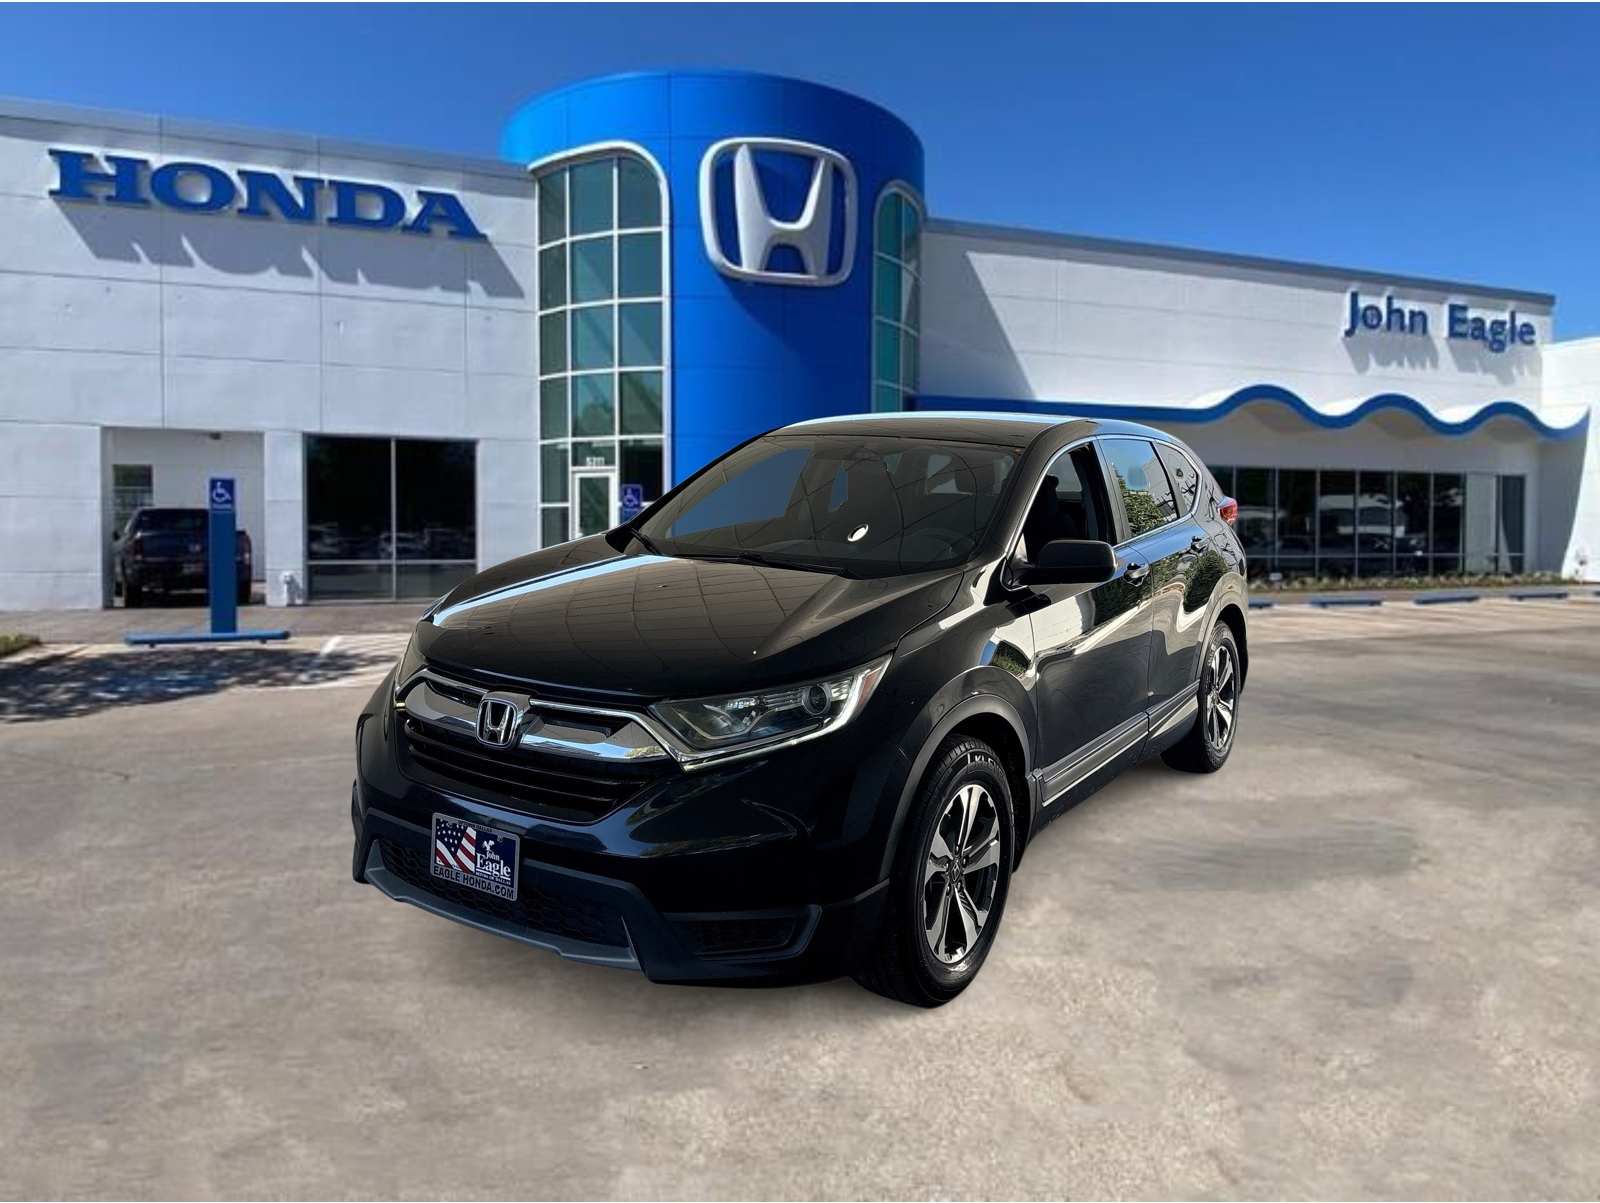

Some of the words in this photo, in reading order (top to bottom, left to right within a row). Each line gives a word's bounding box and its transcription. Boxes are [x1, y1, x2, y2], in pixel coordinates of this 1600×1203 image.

[49, 149, 488, 241] HONDA
[1344, 291, 1428, 338] John
[1448, 303, 1535, 353] Eagle
[476, 852, 511, 877] Eagle
[486, 850, 500, 861] John
[434, 866, 460, 881] EAGLE
